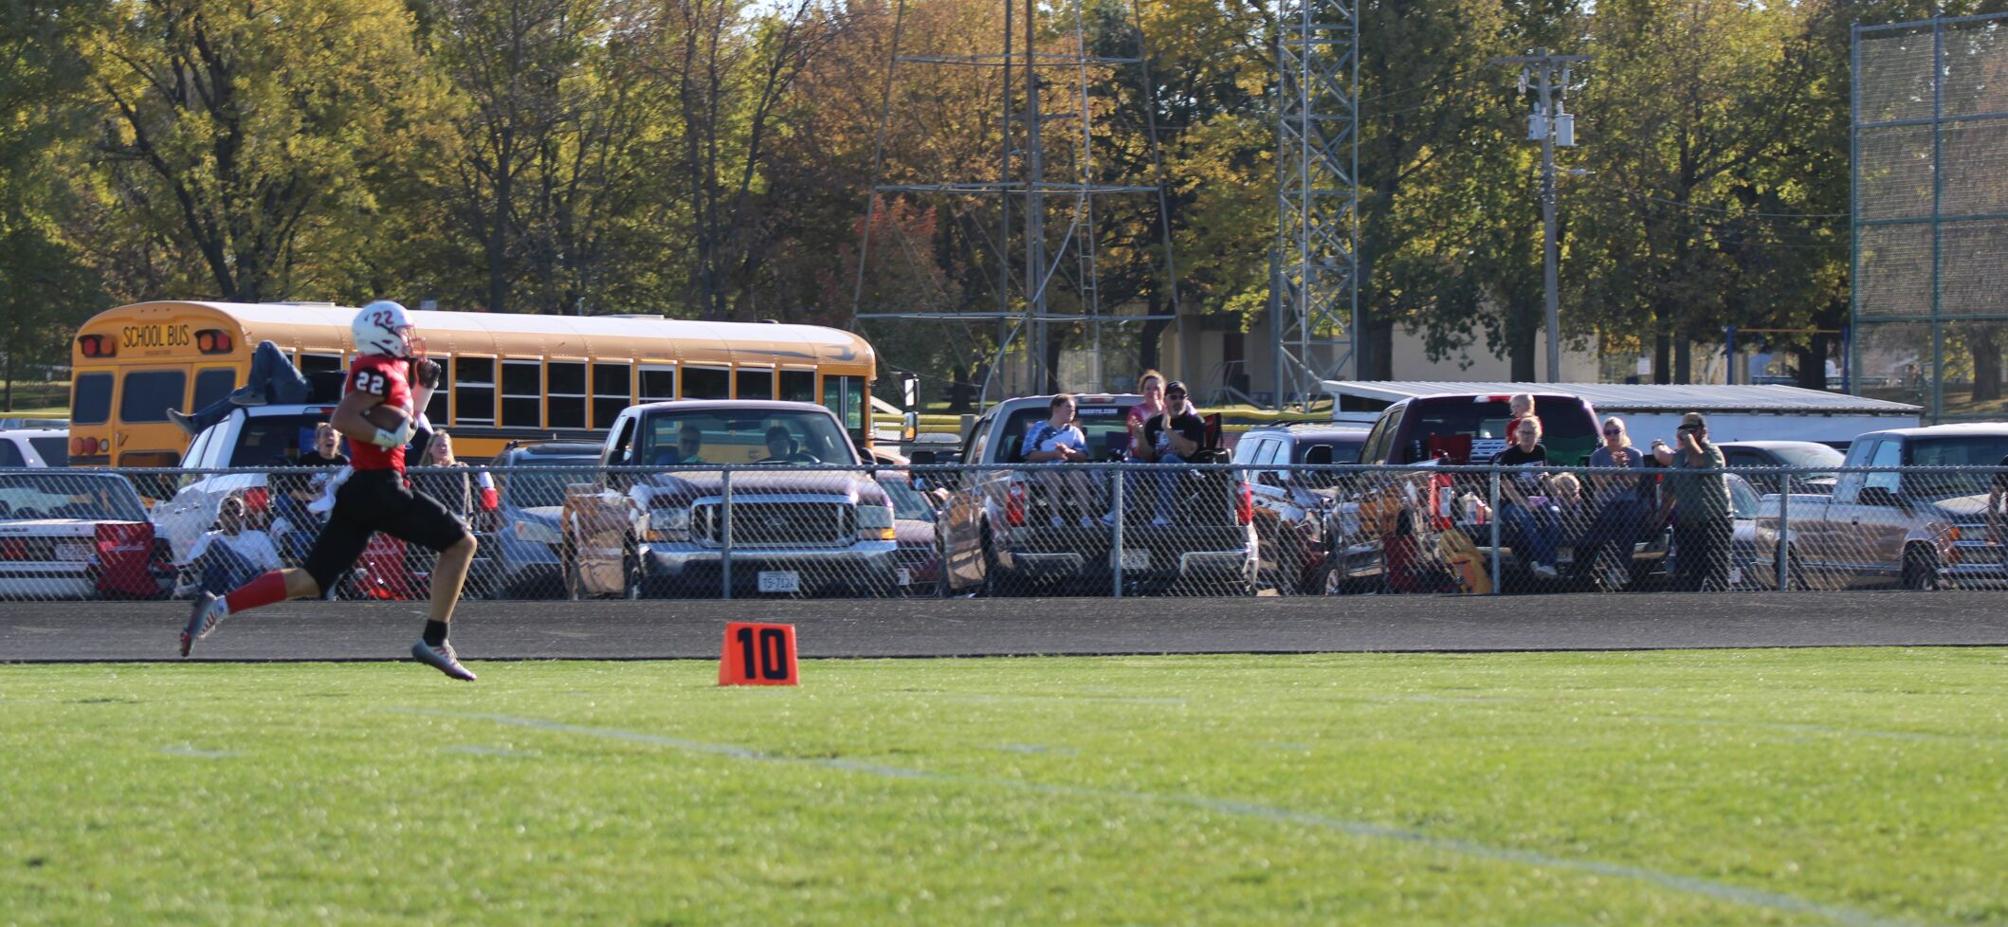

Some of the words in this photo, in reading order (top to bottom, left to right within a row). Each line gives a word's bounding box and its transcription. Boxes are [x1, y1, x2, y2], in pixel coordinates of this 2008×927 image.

[373, 311, 394, 327] 22
[123, 325, 165, 347] SCHOOL
[168, 324, 189, 346] BUS
[356, 371, 384, 395] 22
[737, 627, 788, 679] 10
